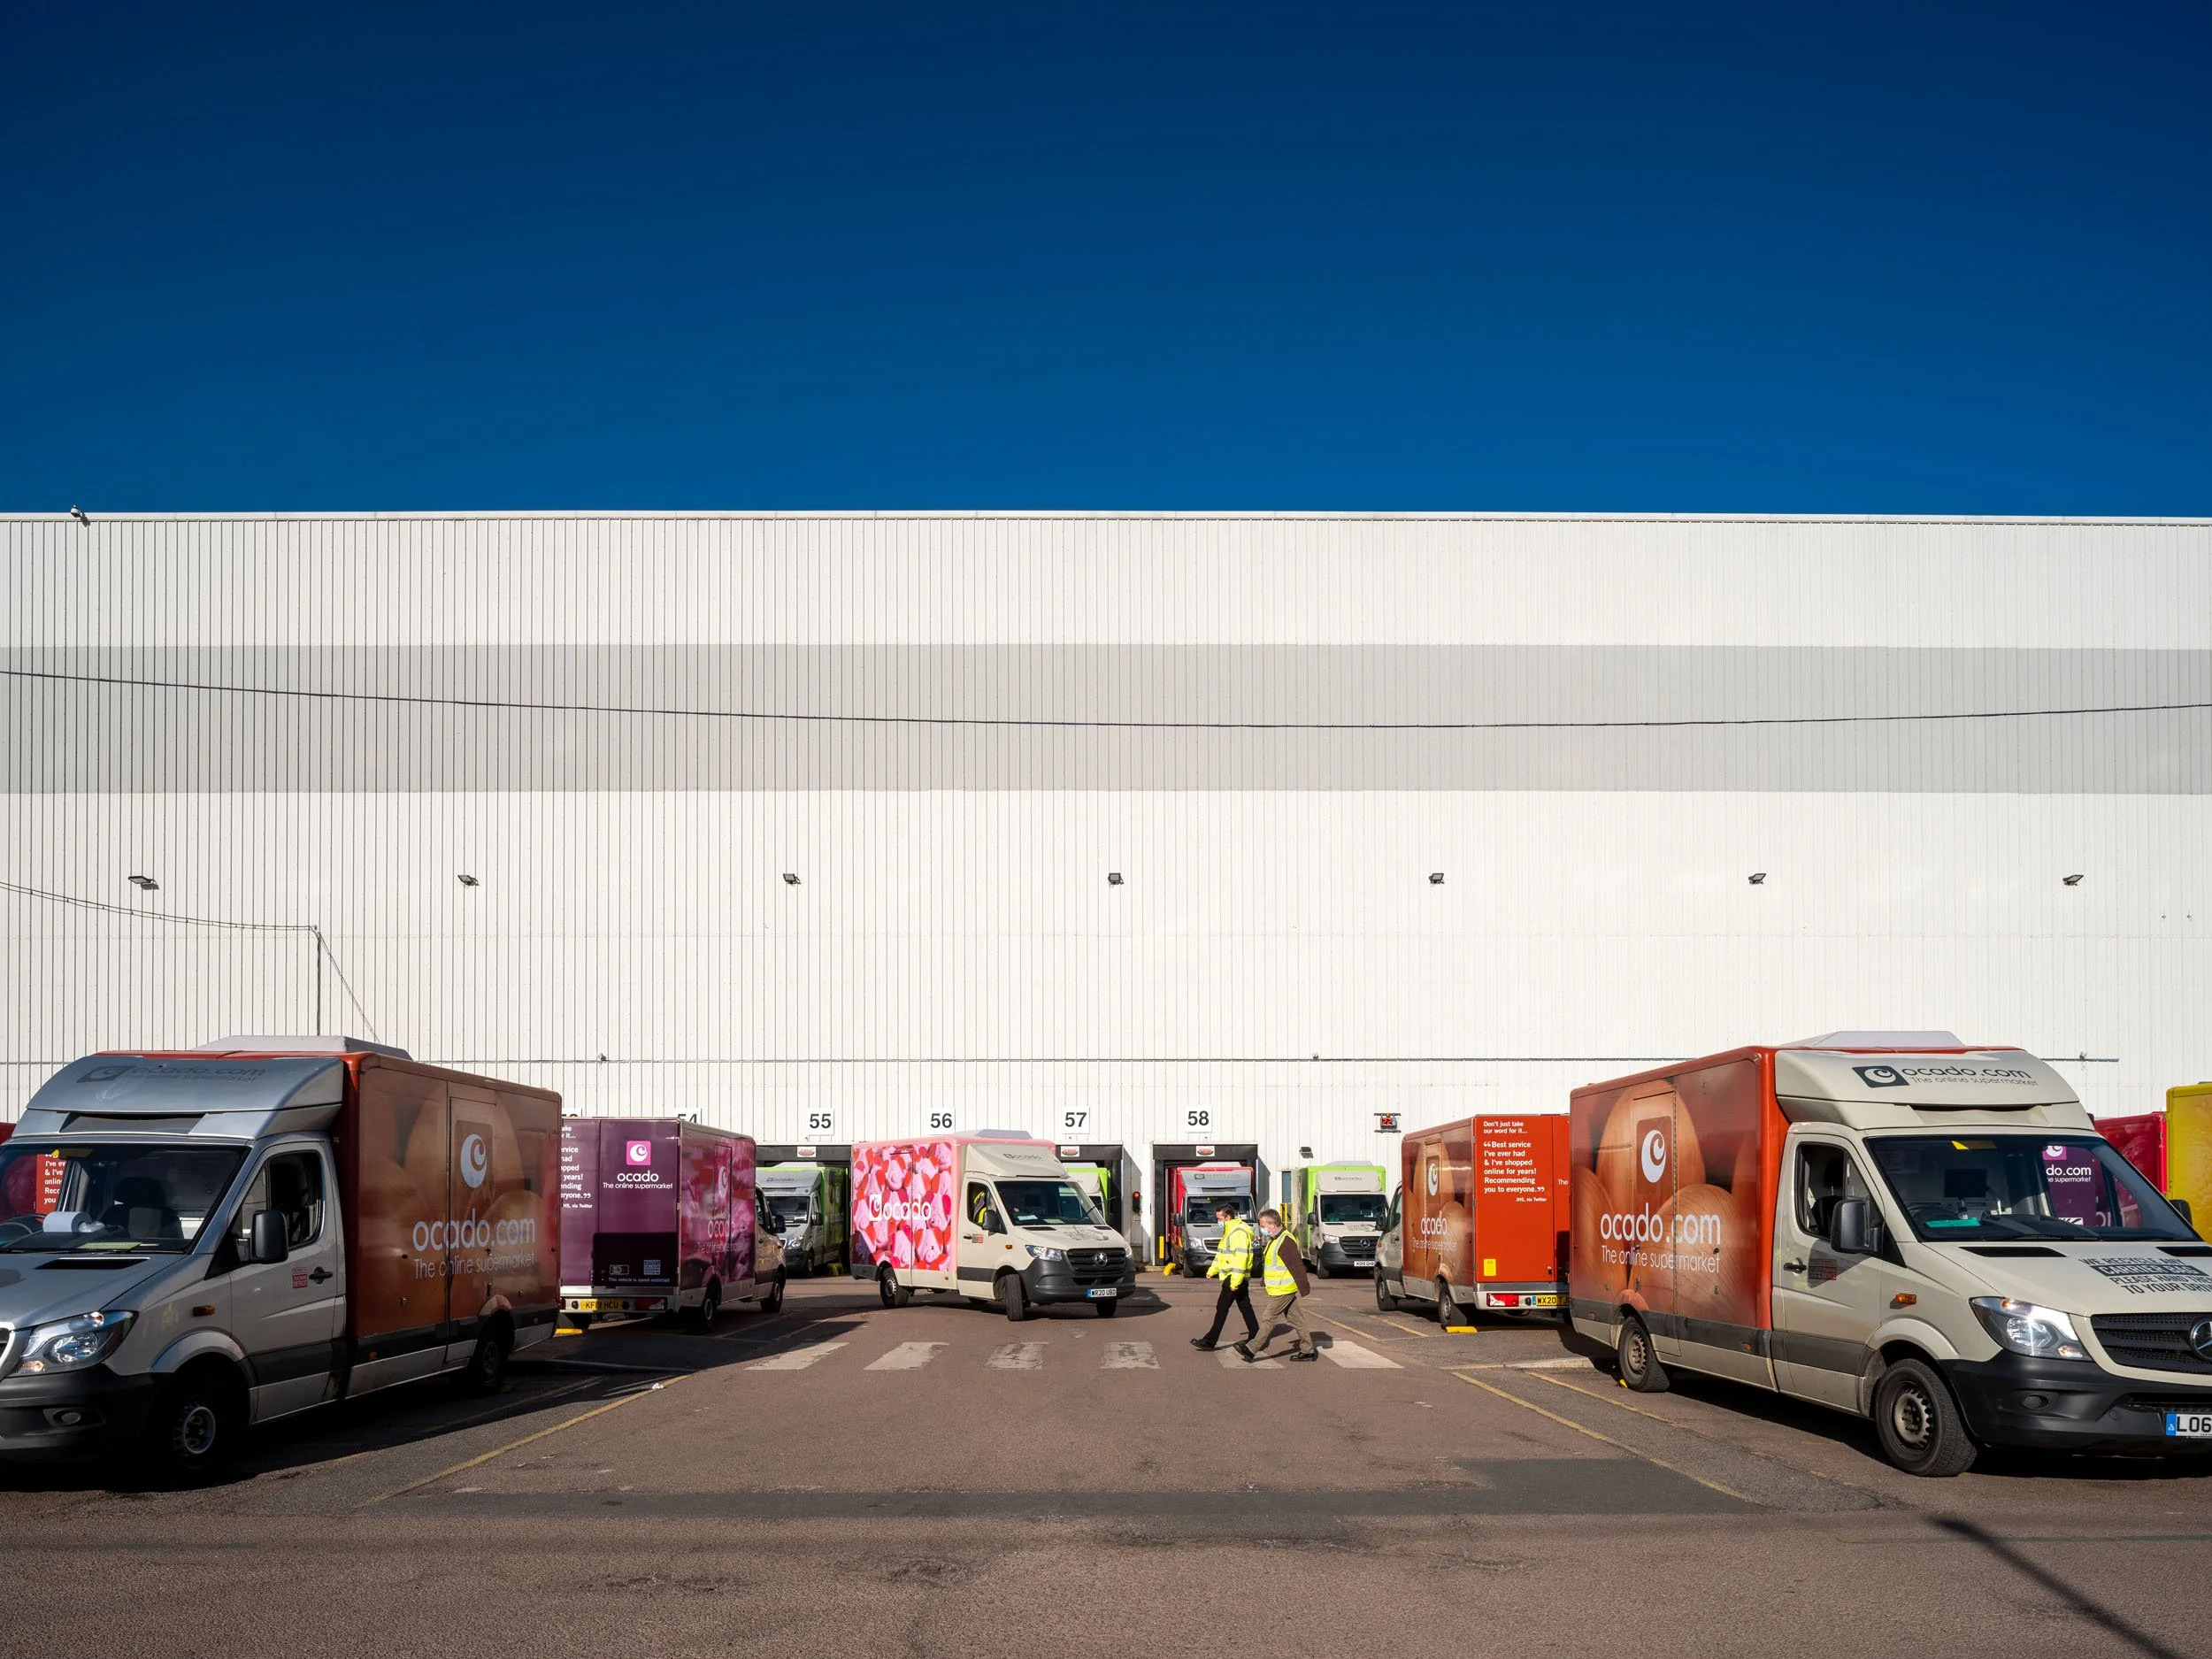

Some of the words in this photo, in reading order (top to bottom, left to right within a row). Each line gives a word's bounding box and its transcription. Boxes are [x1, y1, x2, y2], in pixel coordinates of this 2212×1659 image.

[1901, 1065, 2032, 1079] ocado.com
[1970, 1077, 2039, 1087] supermarket
[678, 1113, 697, 1124] 4
[809, 1113, 832, 1129] 55
[930, 1112, 953, 1129] 56
[1064, 1111, 1087, 1128] 57
[1187, 1110, 1210, 1126] 58
[617, 1170, 659, 1182] ocado
[2046, 1164, 2092, 1176] do.com
[882, 1194, 932, 1221] ocado
[412, 1207, 536, 1252] ocado.com
[1600, 1202, 1721, 1246] ocado.com
[1601, 1245, 1617, 1263] The
[1618, 1246, 1647, 1267] online
[413, 1257, 436, 1279] The
[438, 1254, 474, 1278] online
[475, 1251, 535, 1274] supermarket
[2098, 1265, 2163, 1274] CARRIER
[2109, 1276, 2157, 1285] PLEASE
[2121, 1285, 2145, 1294] TO
[2141, 1283, 2185, 1293] YOUR
[2181, 1283, 2212, 1292] DRI
